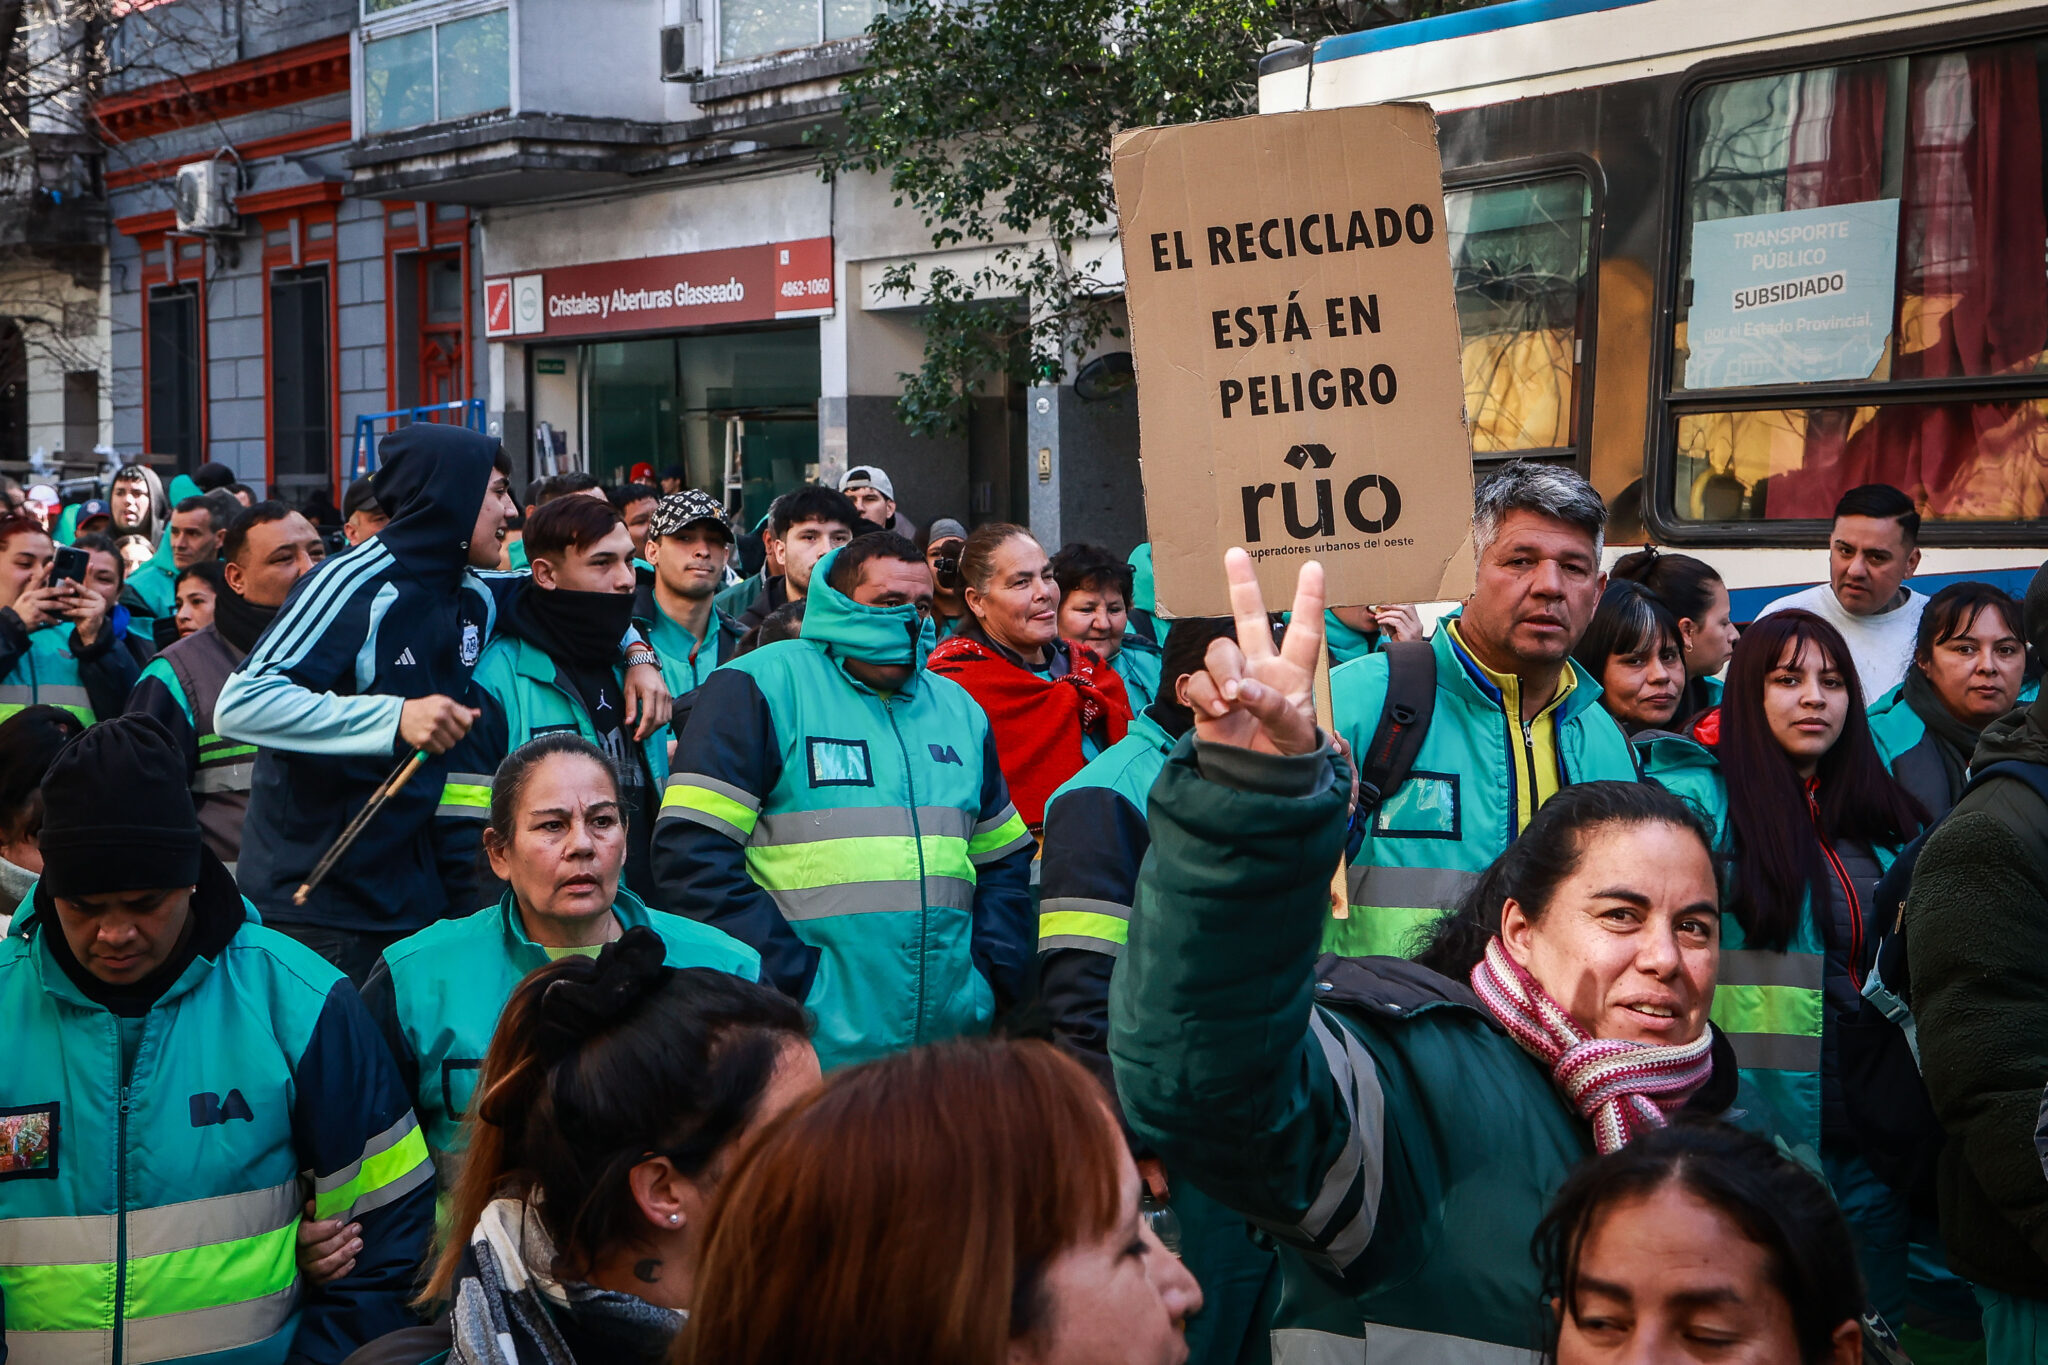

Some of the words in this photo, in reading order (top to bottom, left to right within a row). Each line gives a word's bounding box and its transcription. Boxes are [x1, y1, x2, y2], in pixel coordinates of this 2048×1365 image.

[1151, 231, 1192, 272] EL
[1207, 203, 1433, 266] RECICLADO
[1734, 221, 1849, 249] TRANSPORTE
[1752, 248, 1826, 271] PÚBLICO
[549, 291, 600, 317] Cristales
[601, 299, 610, 318] y
[611, 288, 673, 312] Aberturas
[674, 276, 744, 306] Glasseado
[1734, 274, 1844, 309] SUBSIDIADO
[1212, 290, 1312, 349] ESTÁ
[1326, 294, 1381, 338] EN
[1744, 319, 1792, 336] Estado
[1796, 312, 1873, 332] Provincial.
[1220, 363, 1398, 418] PELIGRO
[1247, 545, 1311, 563] uperadores
[1315, 541, 1360, 553] urbanos
[1364, 537, 1380, 548] del
[1384, 537, 1414, 547] oeste
[928, 744, 963, 767] BA
[189, 1088, 254, 1128] BA
